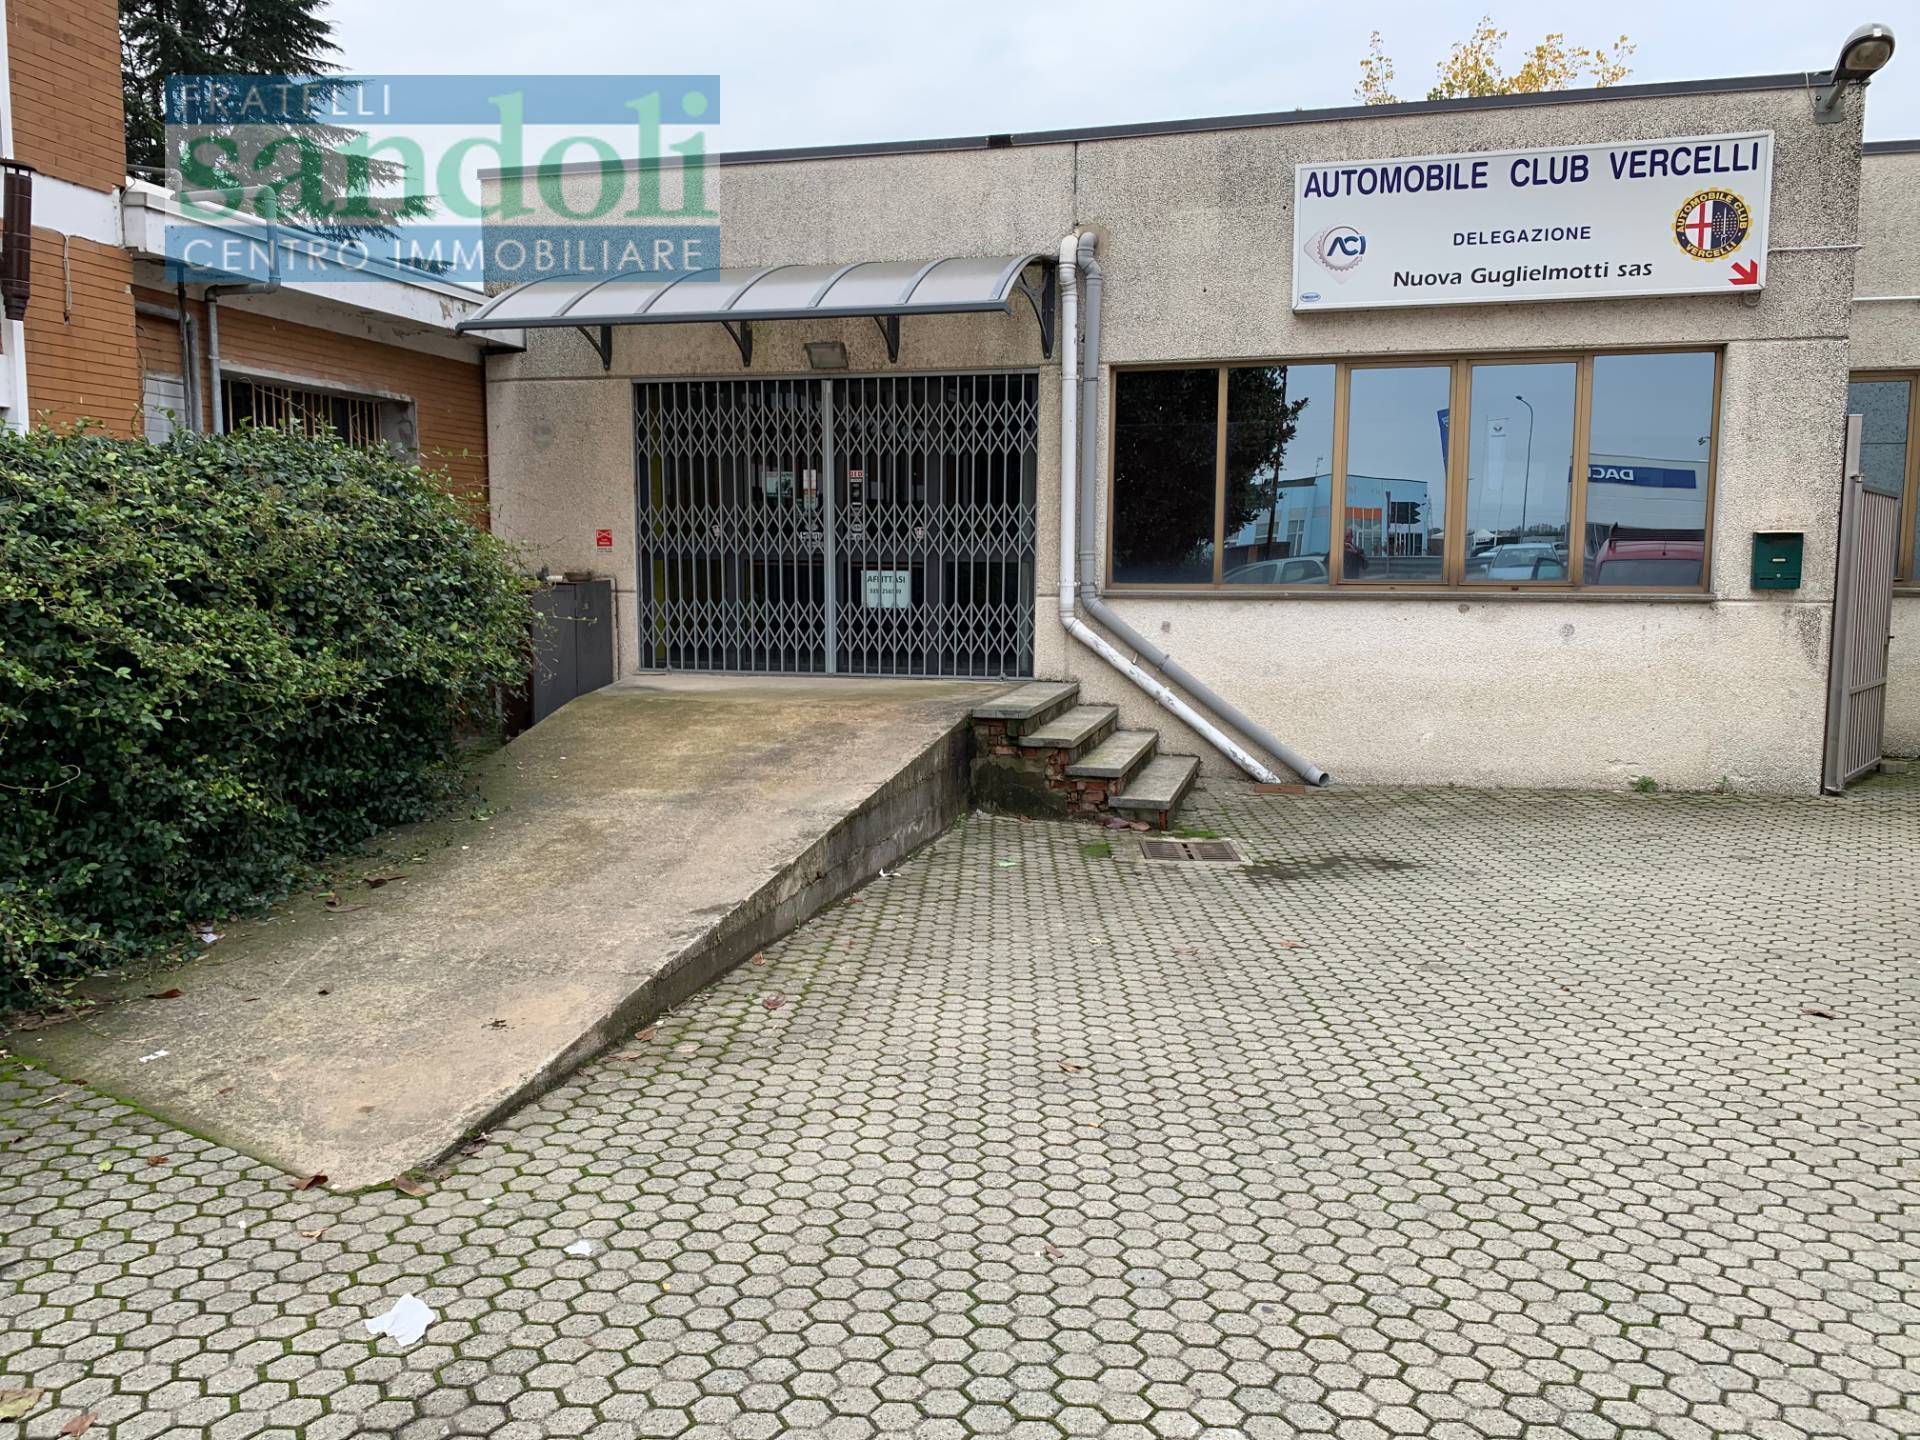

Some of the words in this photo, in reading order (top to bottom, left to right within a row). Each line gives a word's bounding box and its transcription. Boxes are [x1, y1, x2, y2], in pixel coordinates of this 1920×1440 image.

[1303, 161, 1489, 199] AUTOMOBILE
[1510, 154, 1589, 187] CLUB
[1610, 142, 1759, 179] VERCELLI
[1677, 192, 1733, 233] AUTOMOBILE
[1734, 201, 1748, 229] CLUB
[1326, 234, 1367, 257] ACI
[1453, 226, 1591, 245] DELEGAZIONE
[1686, 241, 1737, 258] VERCELLI
[1393, 271, 1462, 287] Nuova
[1471, 261, 1609, 287] Guglielmotti
[1617, 262, 1653, 277] sas
